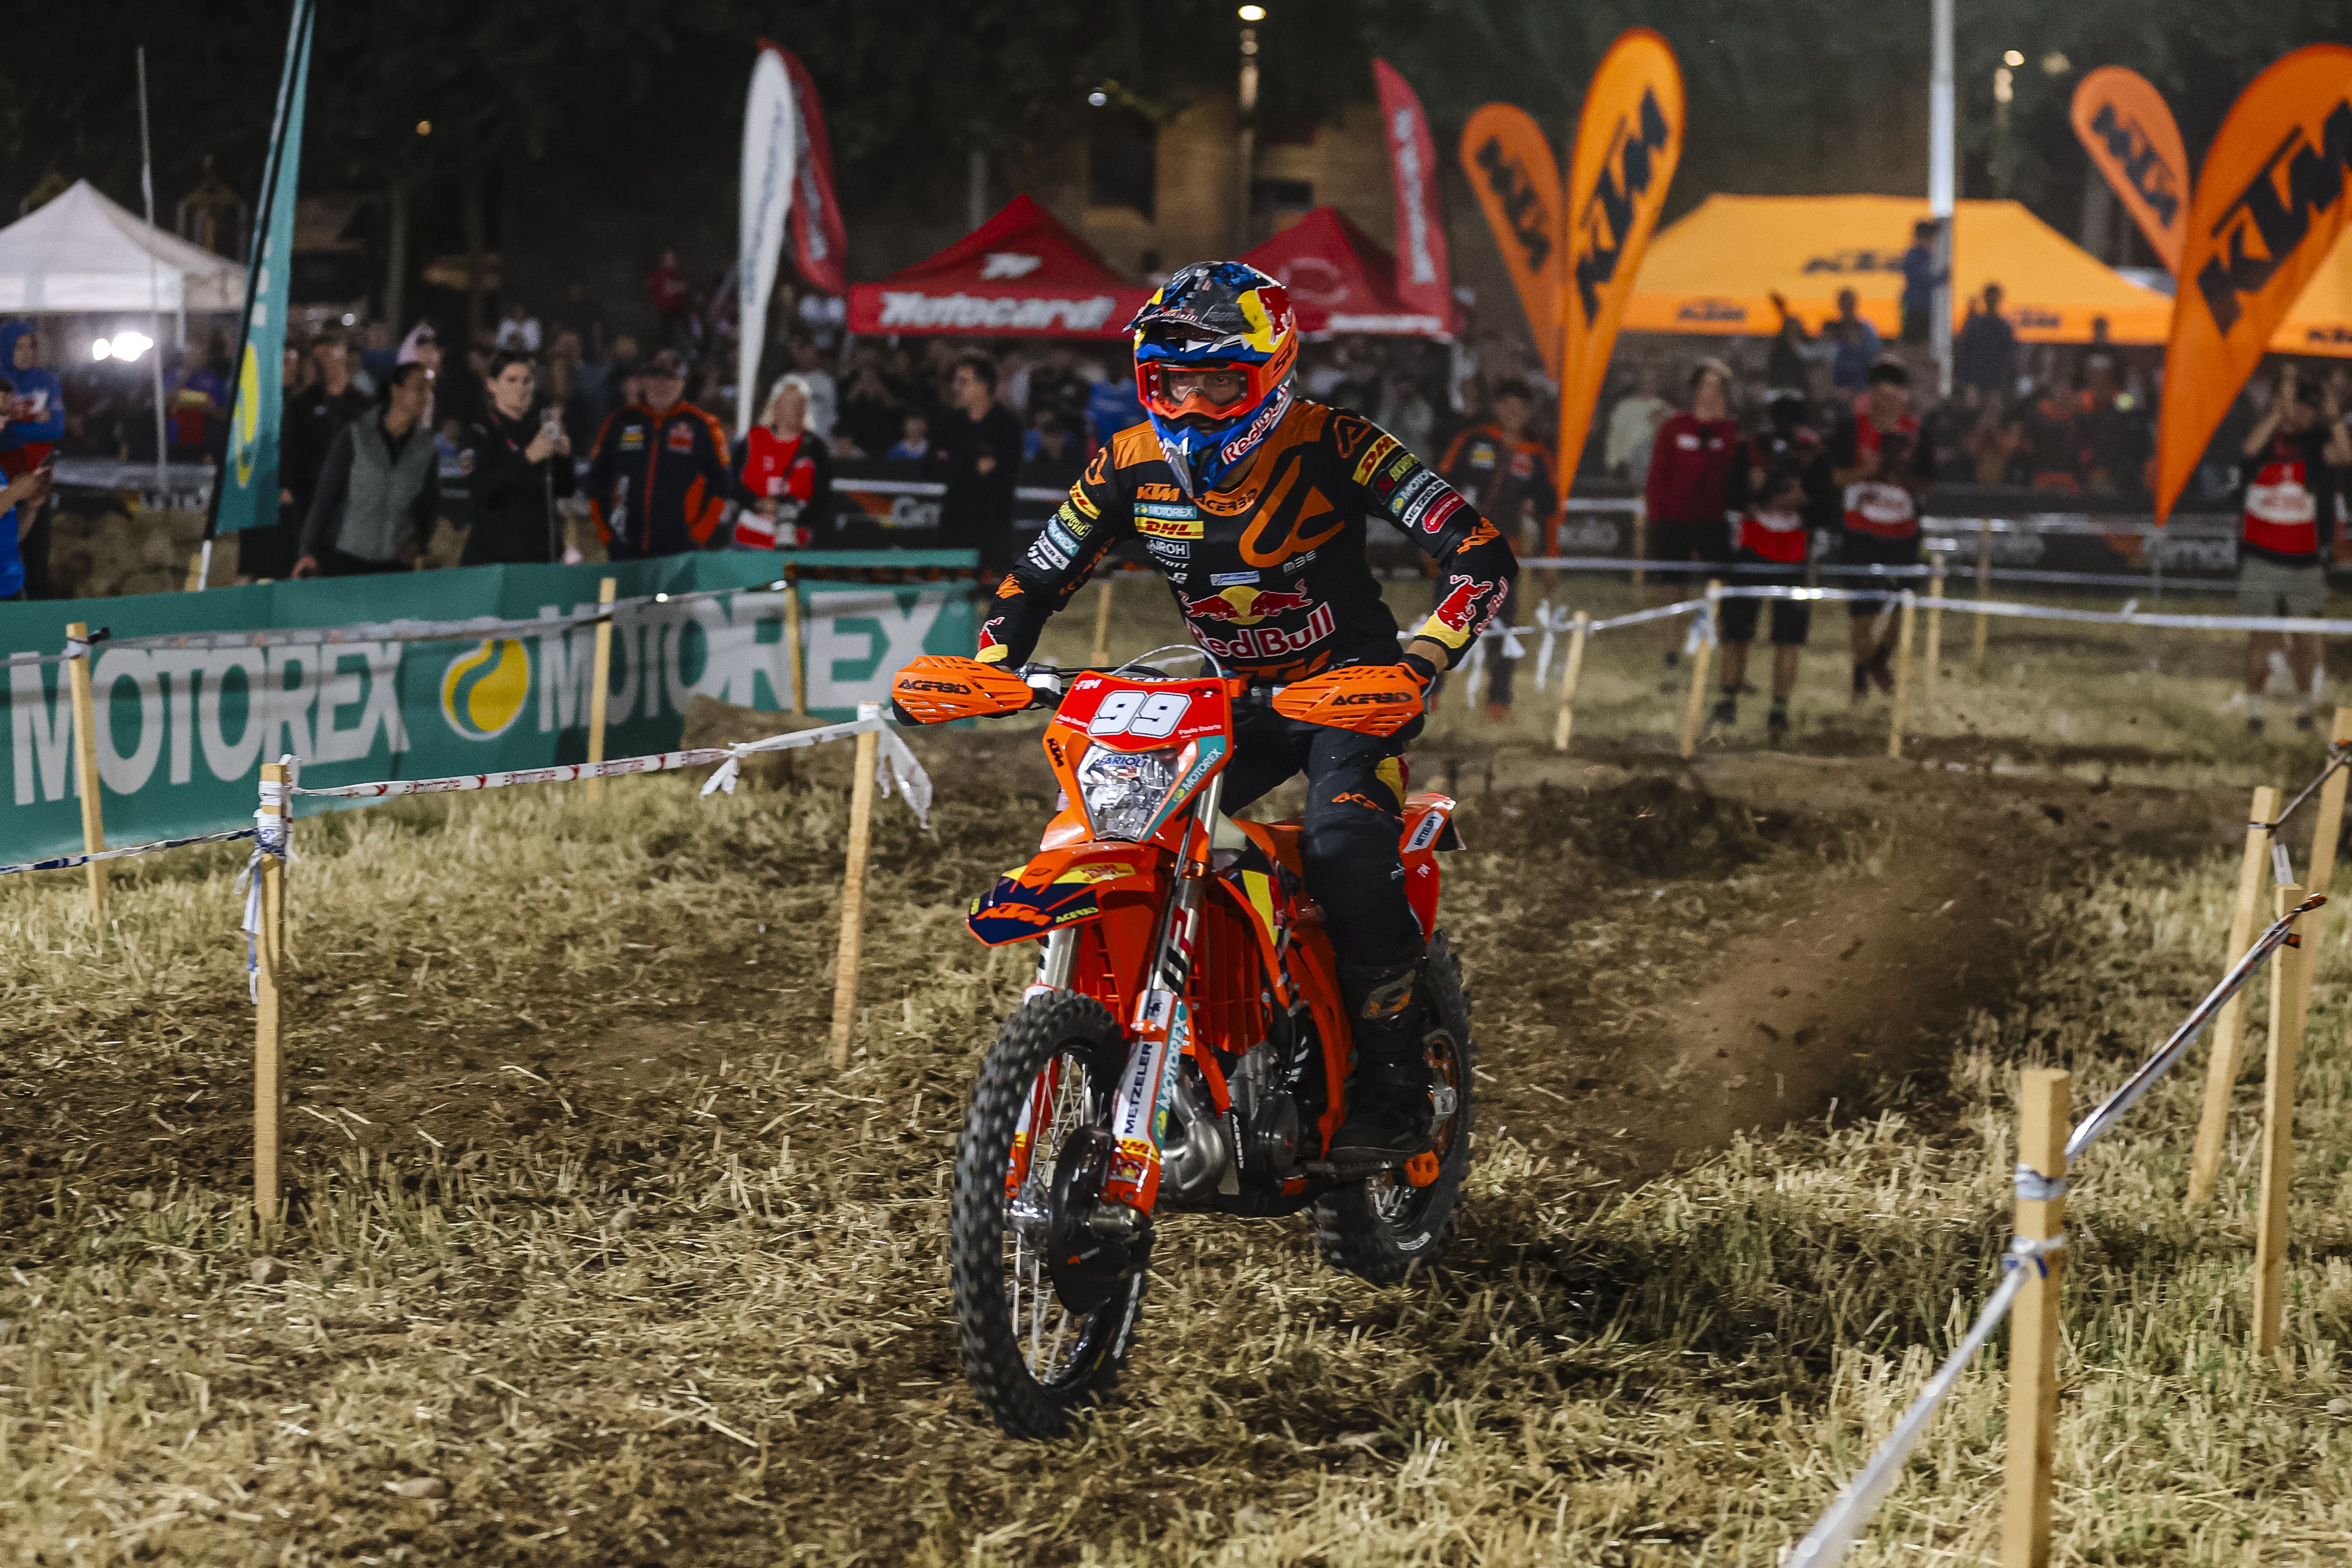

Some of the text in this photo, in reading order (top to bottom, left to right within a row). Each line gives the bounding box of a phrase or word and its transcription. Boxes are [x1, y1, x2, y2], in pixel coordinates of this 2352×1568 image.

[1577, 85, 1669, 330] KTM
[2197, 98, 2352, 338] KTM
[1136, 483, 1180, 501] KTM
[1144, 520, 1192, 535] DHL
[1254, 601, 1335, 657] Bull
[539, 591, 943, 732] MOTOREX
[898, 679, 971, 694] ACERBIS
[1331, 692, 1413, 706] ACERBIS
[10, 642, 410, 805] MOTOREX
[1088, 690, 1192, 739] 99
[1047, 738, 1064, 767] KTM
[1182, 748, 1224, 791] MOTOREX
[975, 902, 1053, 927] KTM
[1156, 1017, 1188, 1109] MOTOREX
[1124, 1043, 1152, 1134] METZELER
